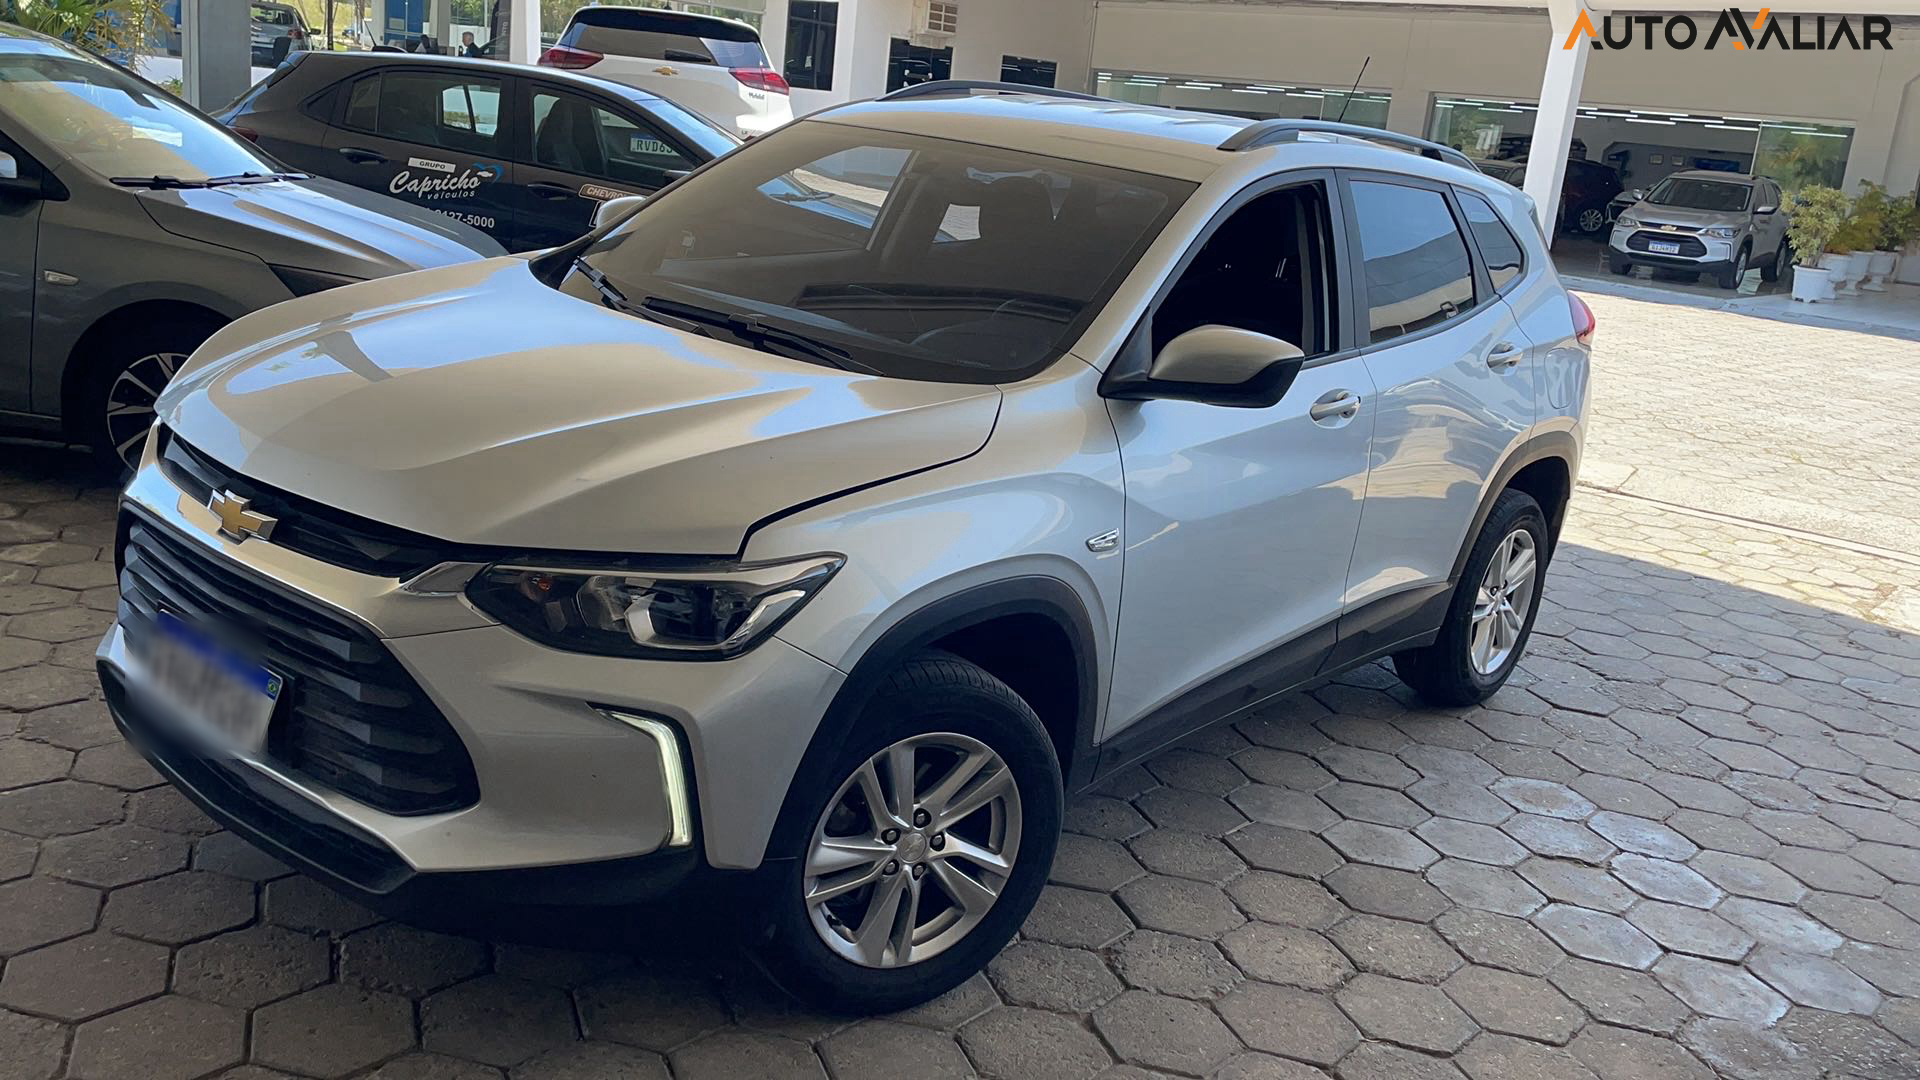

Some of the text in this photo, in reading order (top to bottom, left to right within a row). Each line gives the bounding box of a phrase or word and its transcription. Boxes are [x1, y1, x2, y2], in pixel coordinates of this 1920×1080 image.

[419, 160, 446, 170] GRUPO
[389, 169, 481, 198] Capricho
[586, 187, 625, 199] CHEVRO
